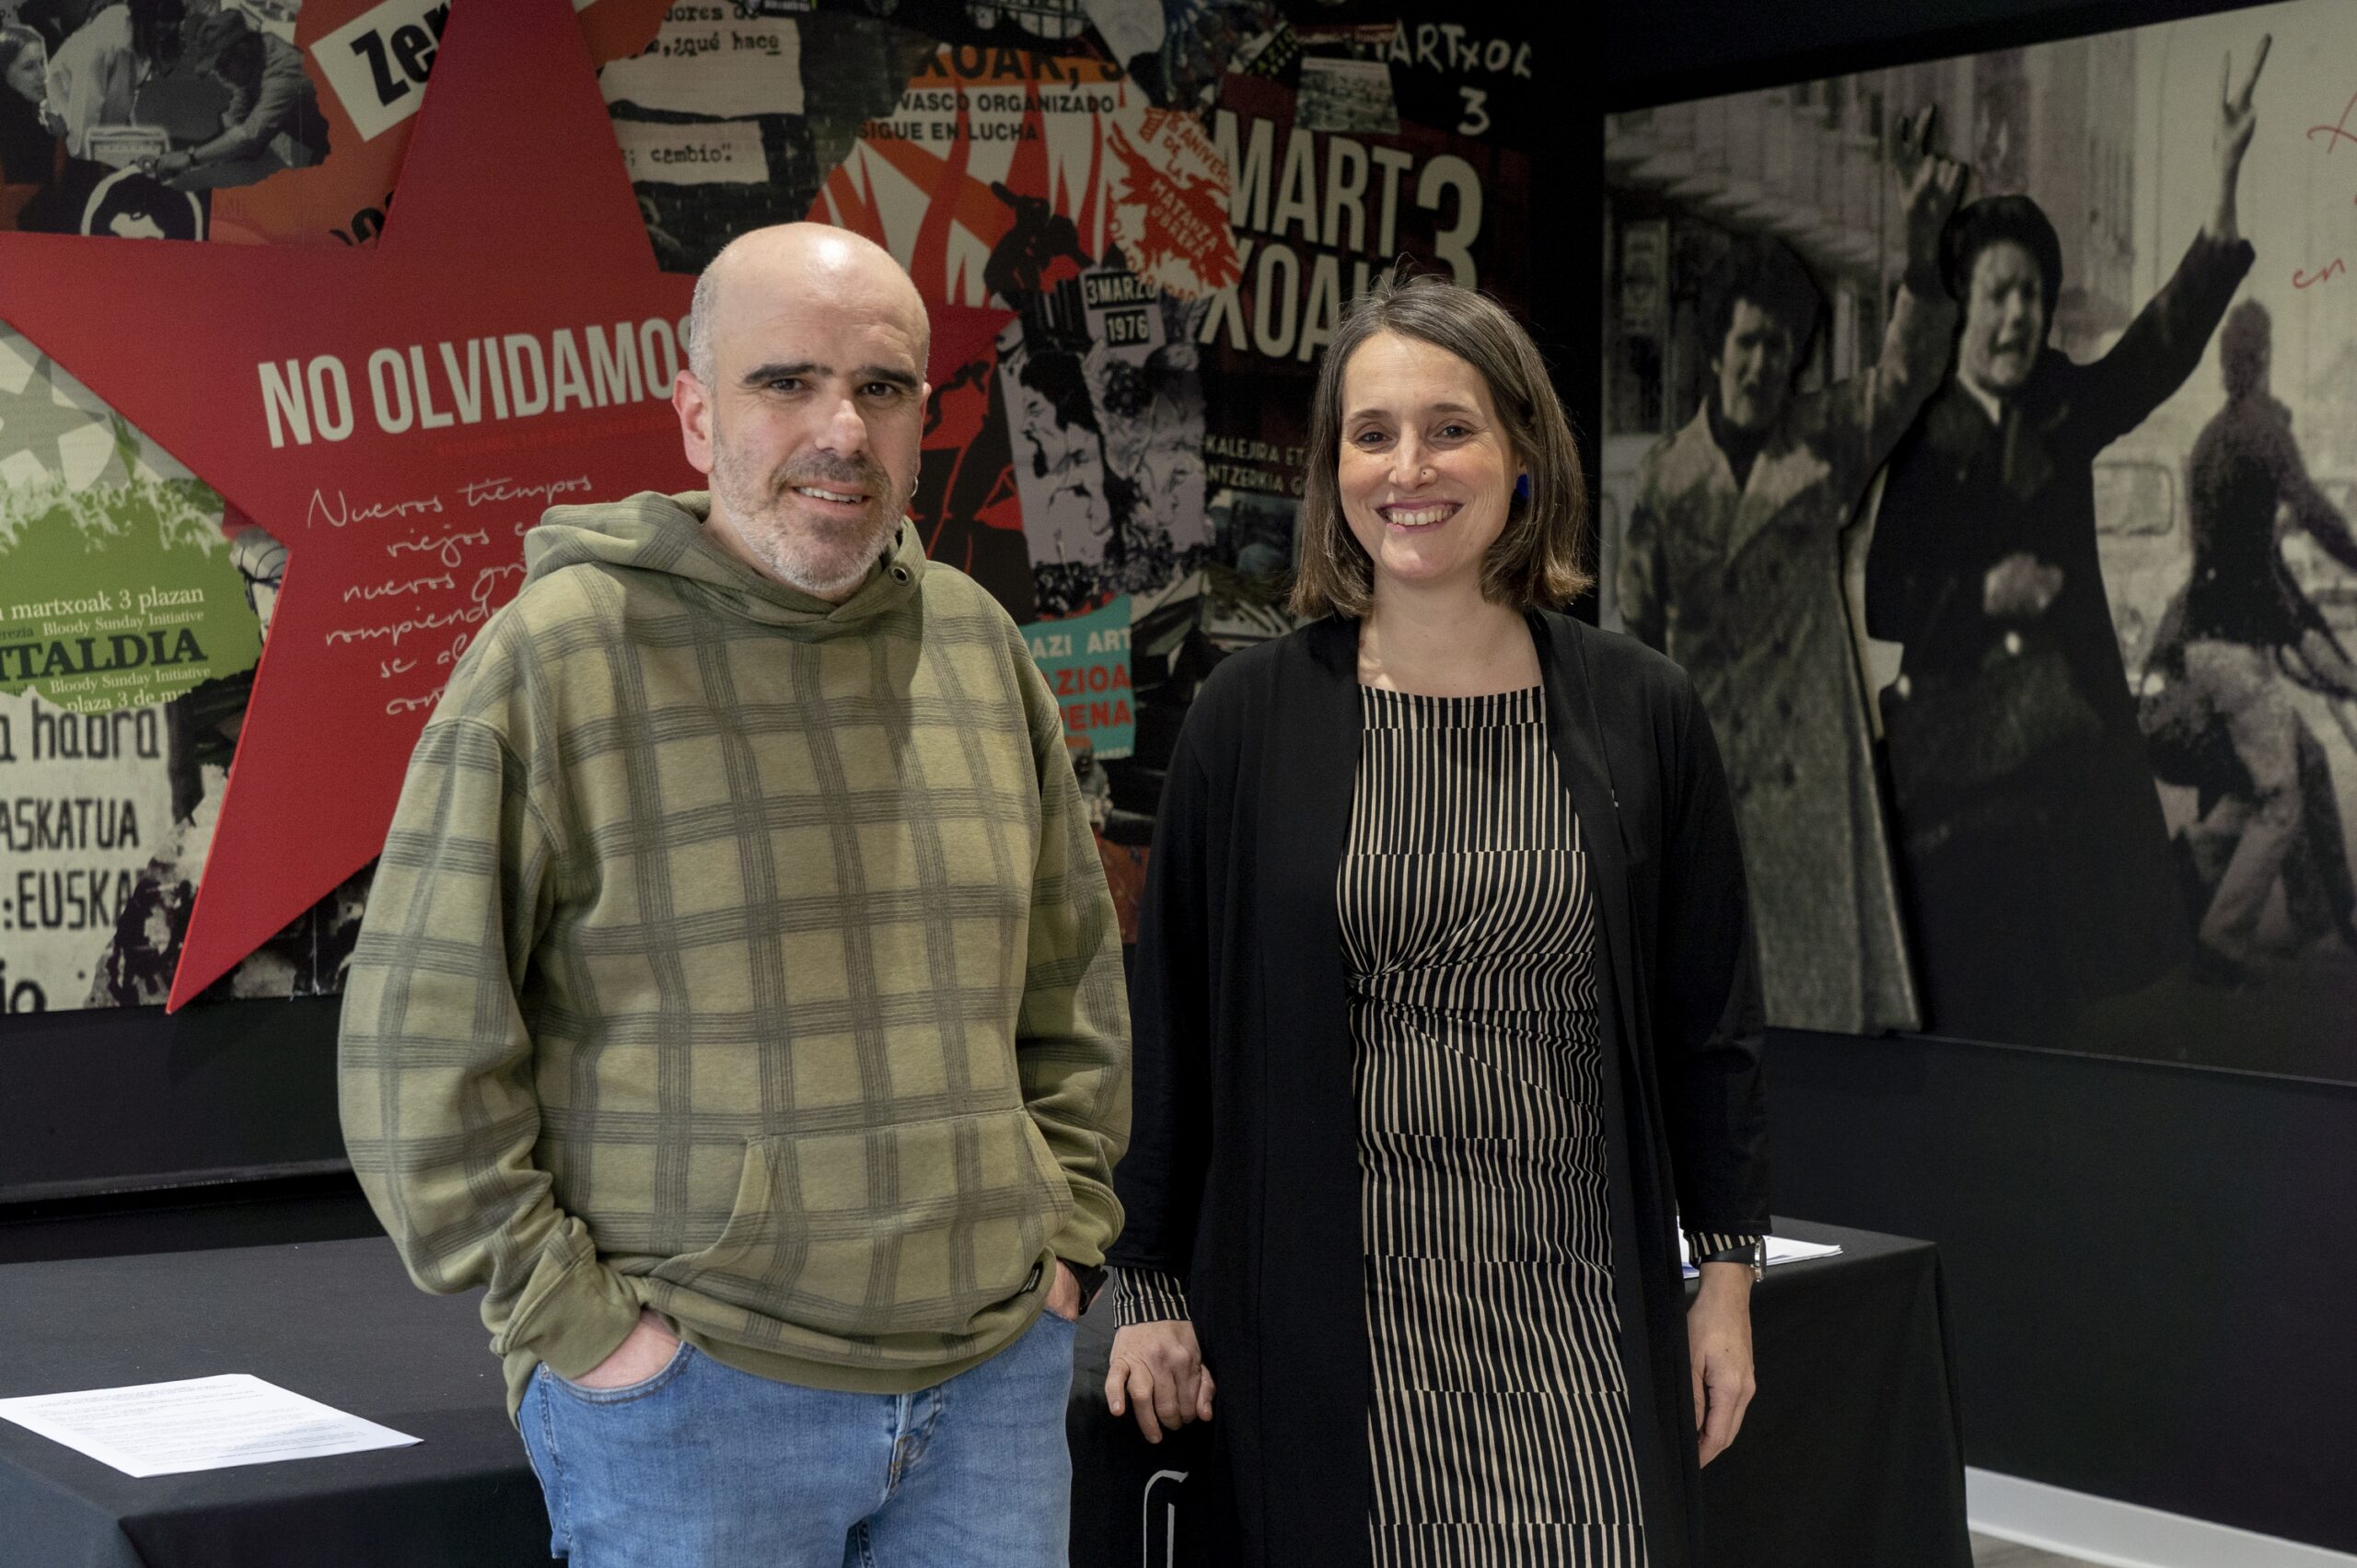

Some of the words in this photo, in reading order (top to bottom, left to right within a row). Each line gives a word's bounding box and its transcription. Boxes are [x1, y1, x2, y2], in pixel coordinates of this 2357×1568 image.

[900, 93, 970, 112] VASCO
[978, 92, 1114, 113] ORGANIZADO
[1457, 85, 1492, 137] 3
[929, 122, 958, 141] EN
[969, 122, 1039, 142] LUCHA
[1214, 108, 1414, 260] MART
[1416, 153, 1484, 291] 3
[1107, 314, 1149, 343] 1976
[258, 354, 355, 449] NO
[307, 487, 444, 529] Nuevos
[457, 473, 593, 507] tiempos
[387, 523, 491, 568] viejos
[343, 570, 456, 603] nuevos
[12, 590, 113, 620] martxoak
[119, 588, 133, 610] 3
[138, 586, 204, 614] plazan
[43, 620, 91, 637] Bloody
[95, 614, 145, 631] Sunday
[148, 610, 204, 627] Initiative
[51, 678, 98, 695] Bloody
[102, 673, 151, 690] Sunday
[156, 667, 212, 683] Initiative
[380, 657, 418, 679] se
[117, 691, 131, 709] 3
[134, 688, 156, 707] de
